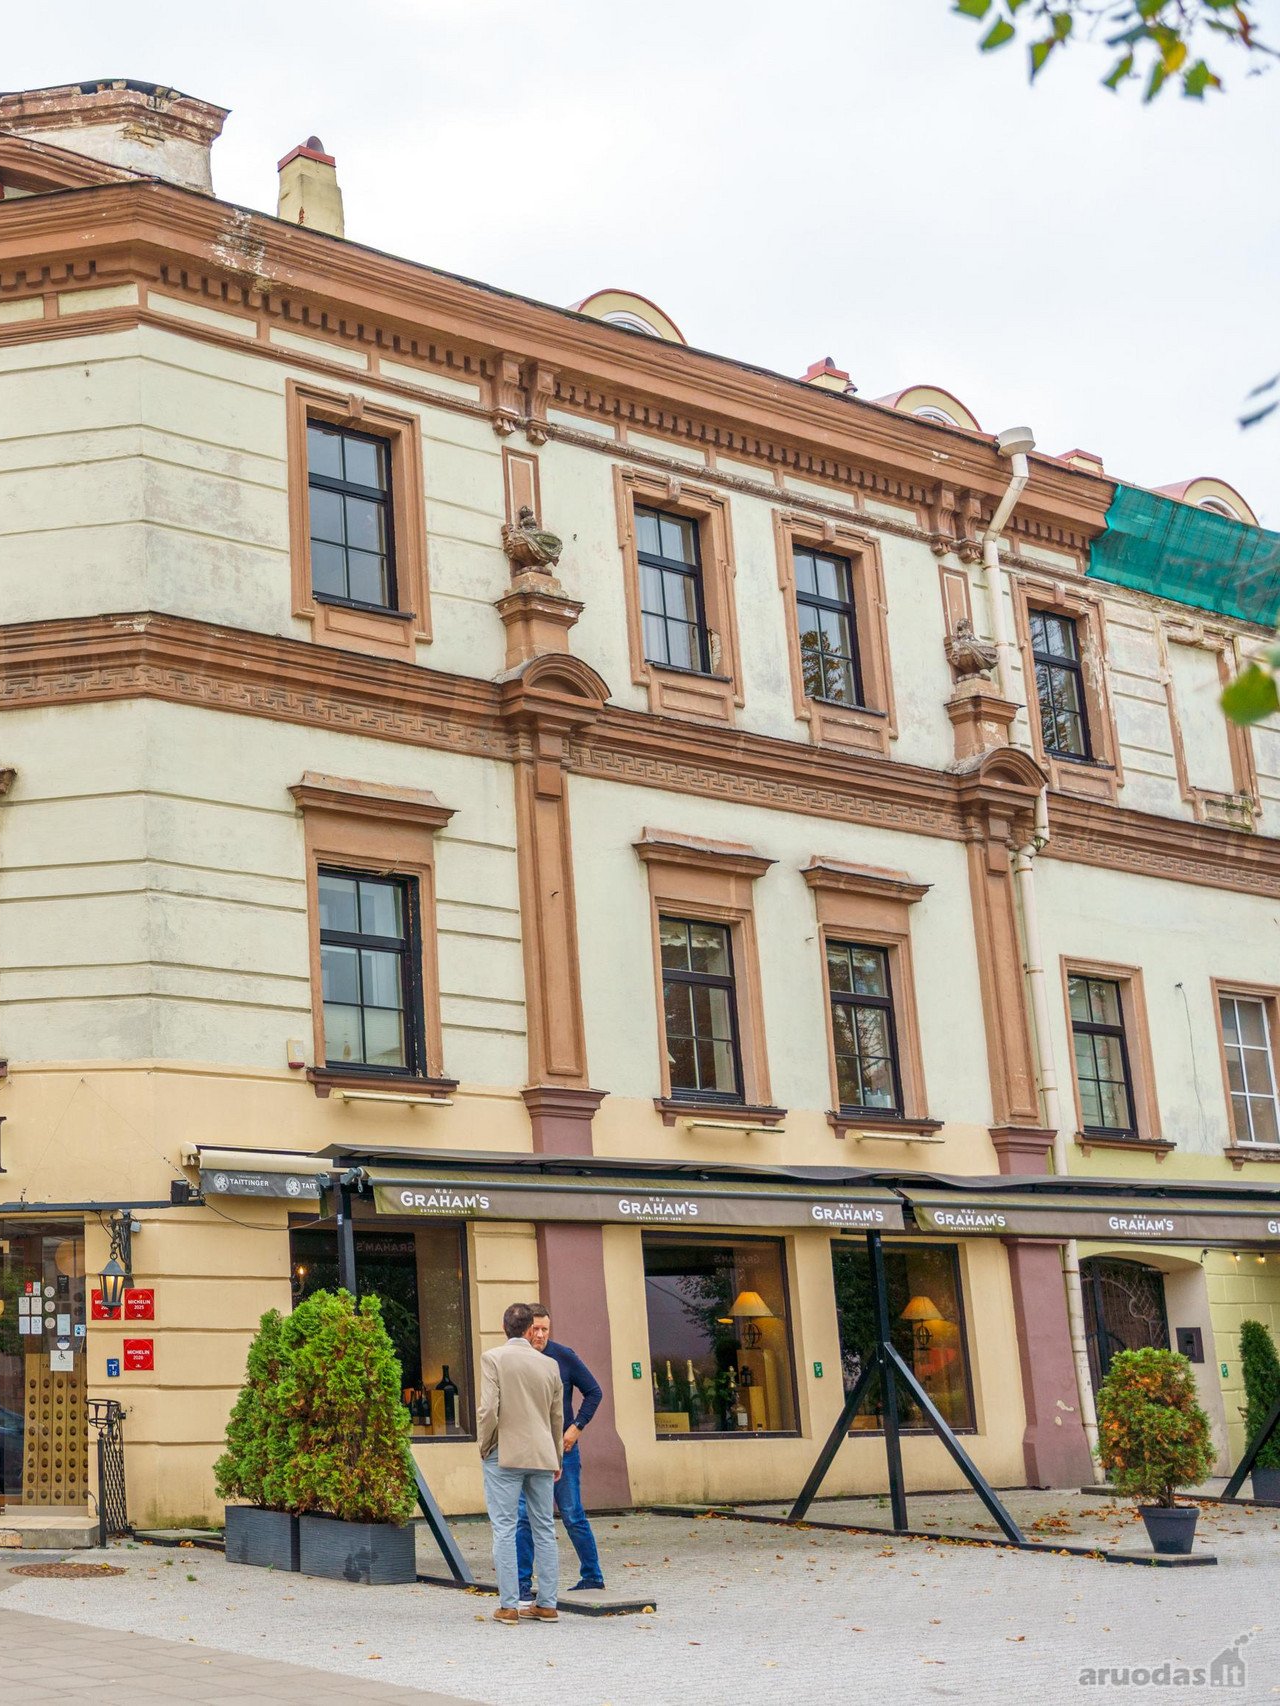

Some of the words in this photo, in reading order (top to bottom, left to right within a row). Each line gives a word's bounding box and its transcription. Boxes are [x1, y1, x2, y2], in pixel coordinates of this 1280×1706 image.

[229, 1178, 270, 1187] TAITTINGER
[400, 1190, 490, 1209] GRAHAM'S
[618, 1199, 698, 1216] GRAHAM'S
[811, 1205, 884, 1222] GRAHAM'S
[933, 1210, 1006, 1227] GRAHAM'S
[1108, 1216, 1174, 1231] GRAHAM'S
